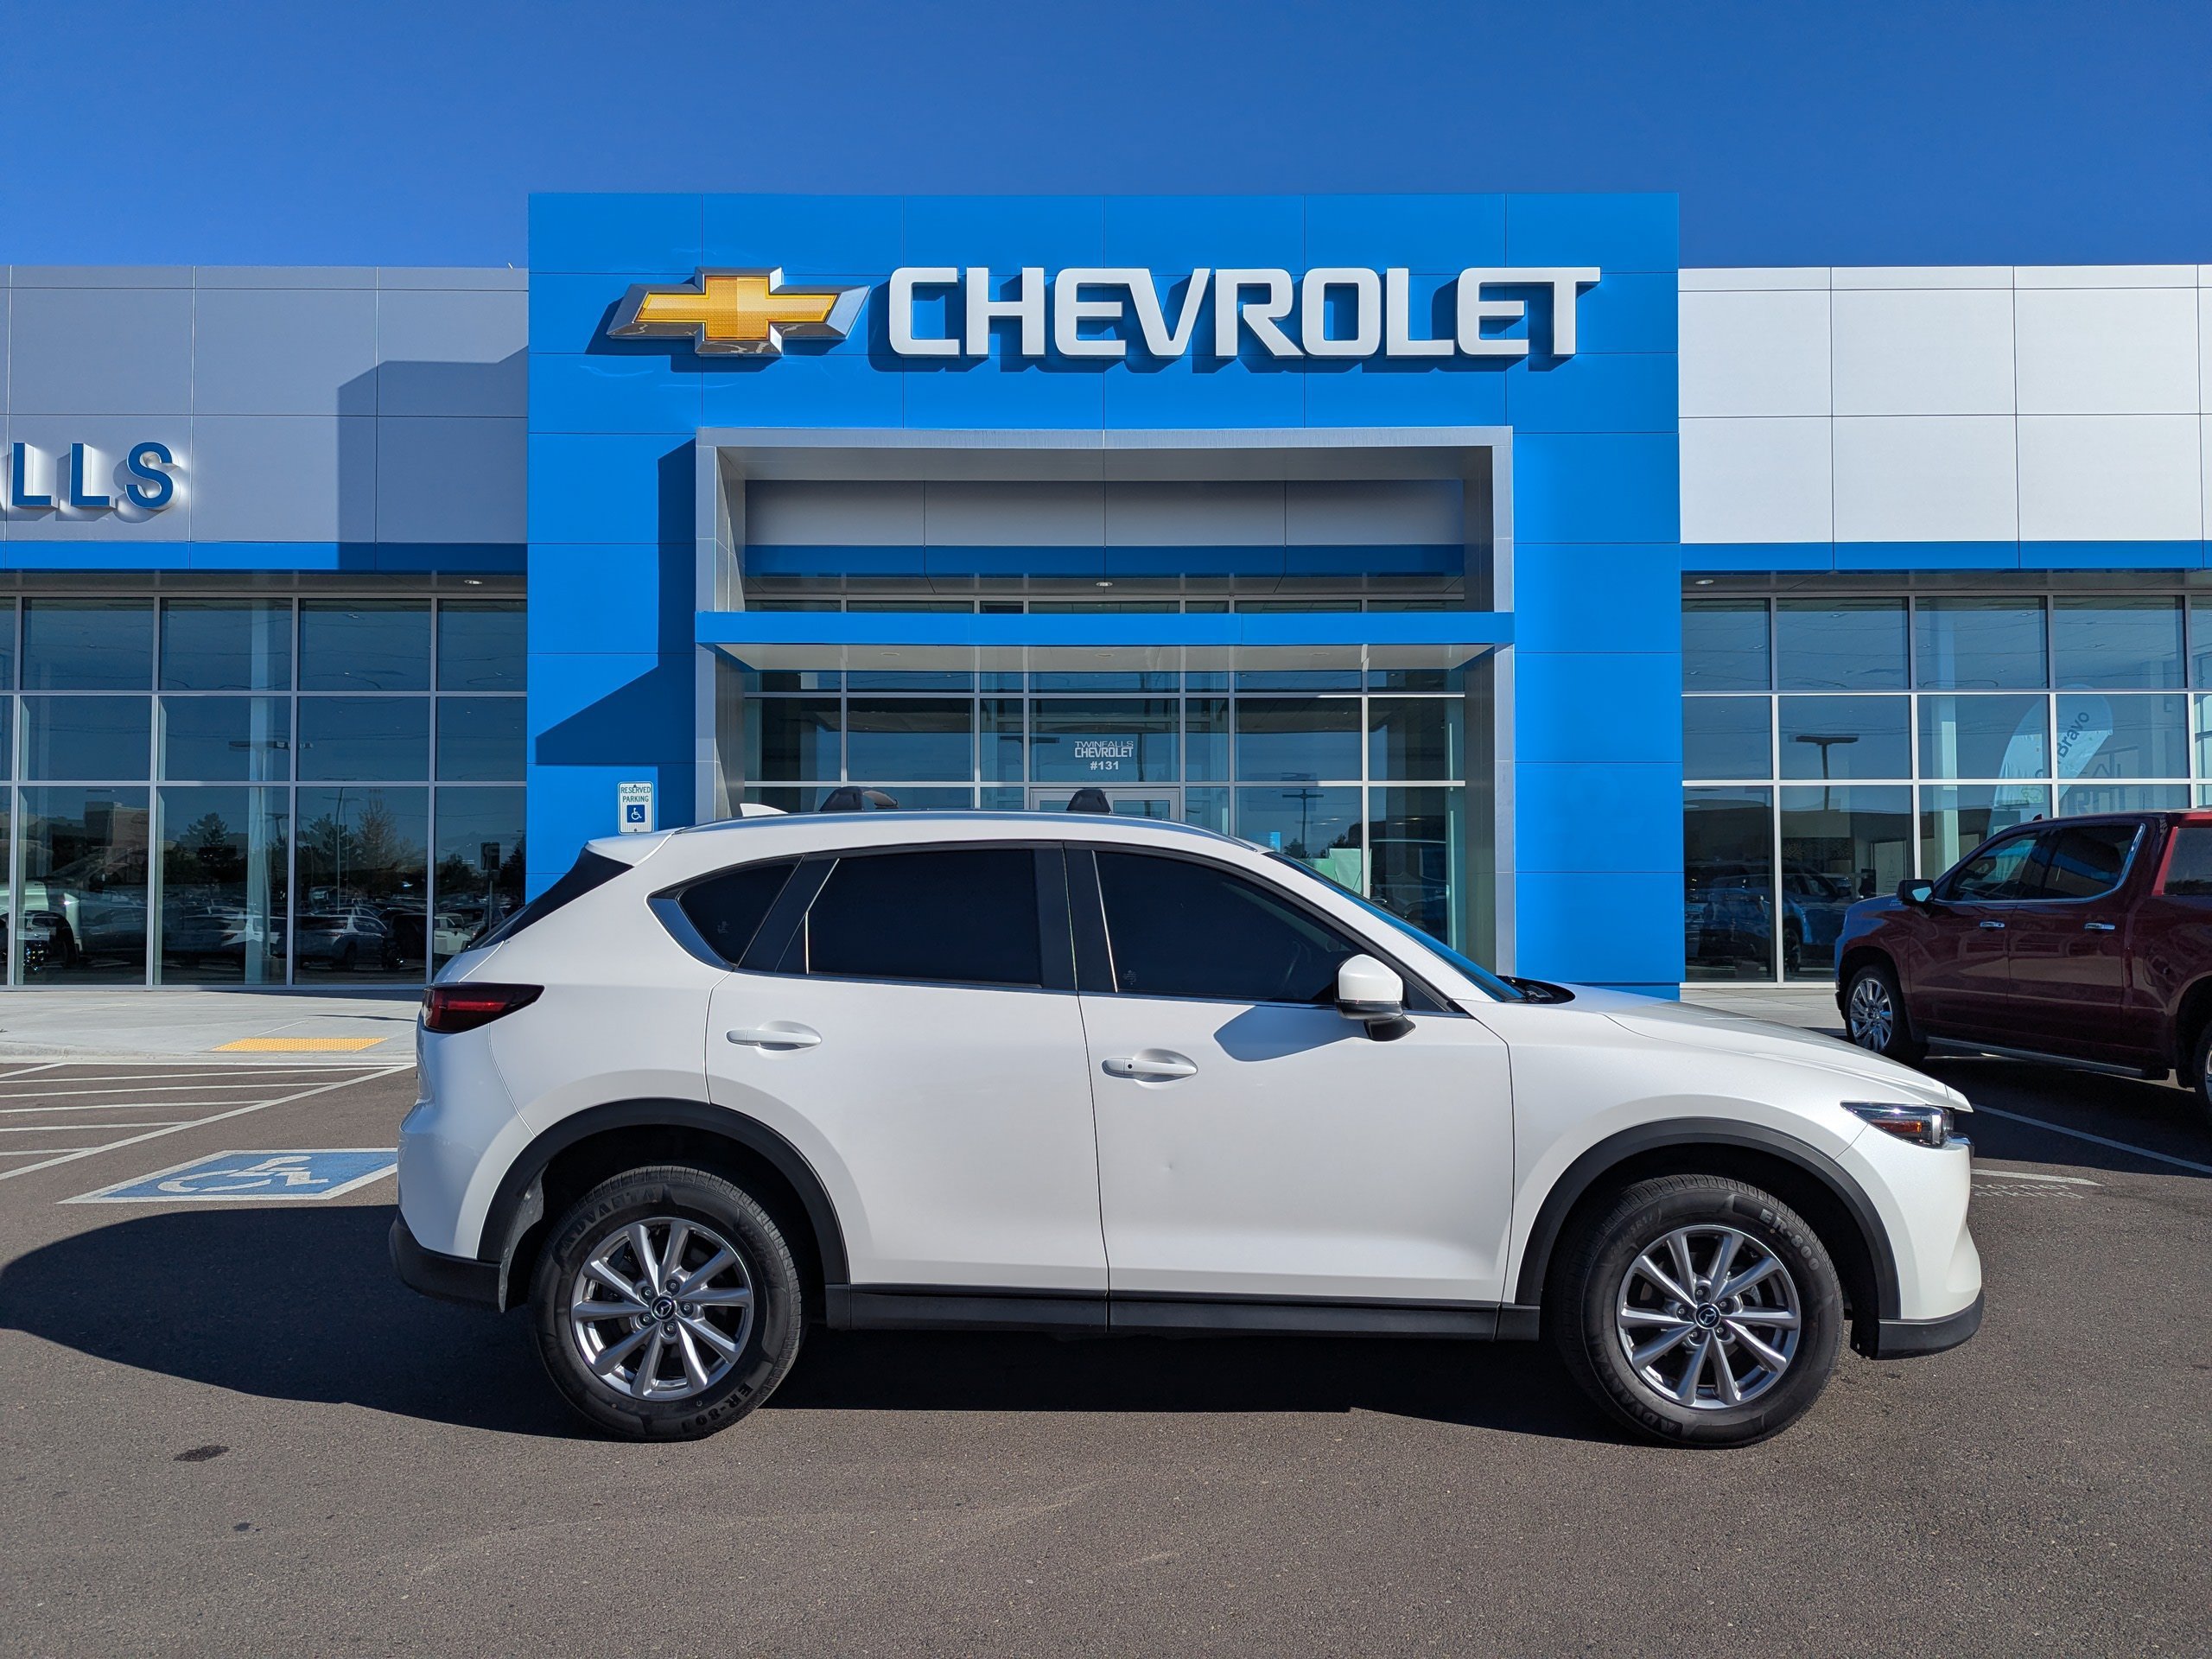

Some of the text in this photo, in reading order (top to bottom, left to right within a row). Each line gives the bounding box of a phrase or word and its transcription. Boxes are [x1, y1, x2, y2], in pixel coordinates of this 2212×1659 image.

[889, 266, 1601, 358] CHEVROLET
[10, 442, 175, 509] LLS
[1075, 747, 1134, 758] CHEVROLET
[1090, 760, 1120, 771] #131
[2057, 712, 2089, 758] Bravo
[558, 1185, 658, 1252] ADVANTA
[1759, 1208, 1820, 1271] ER-800
